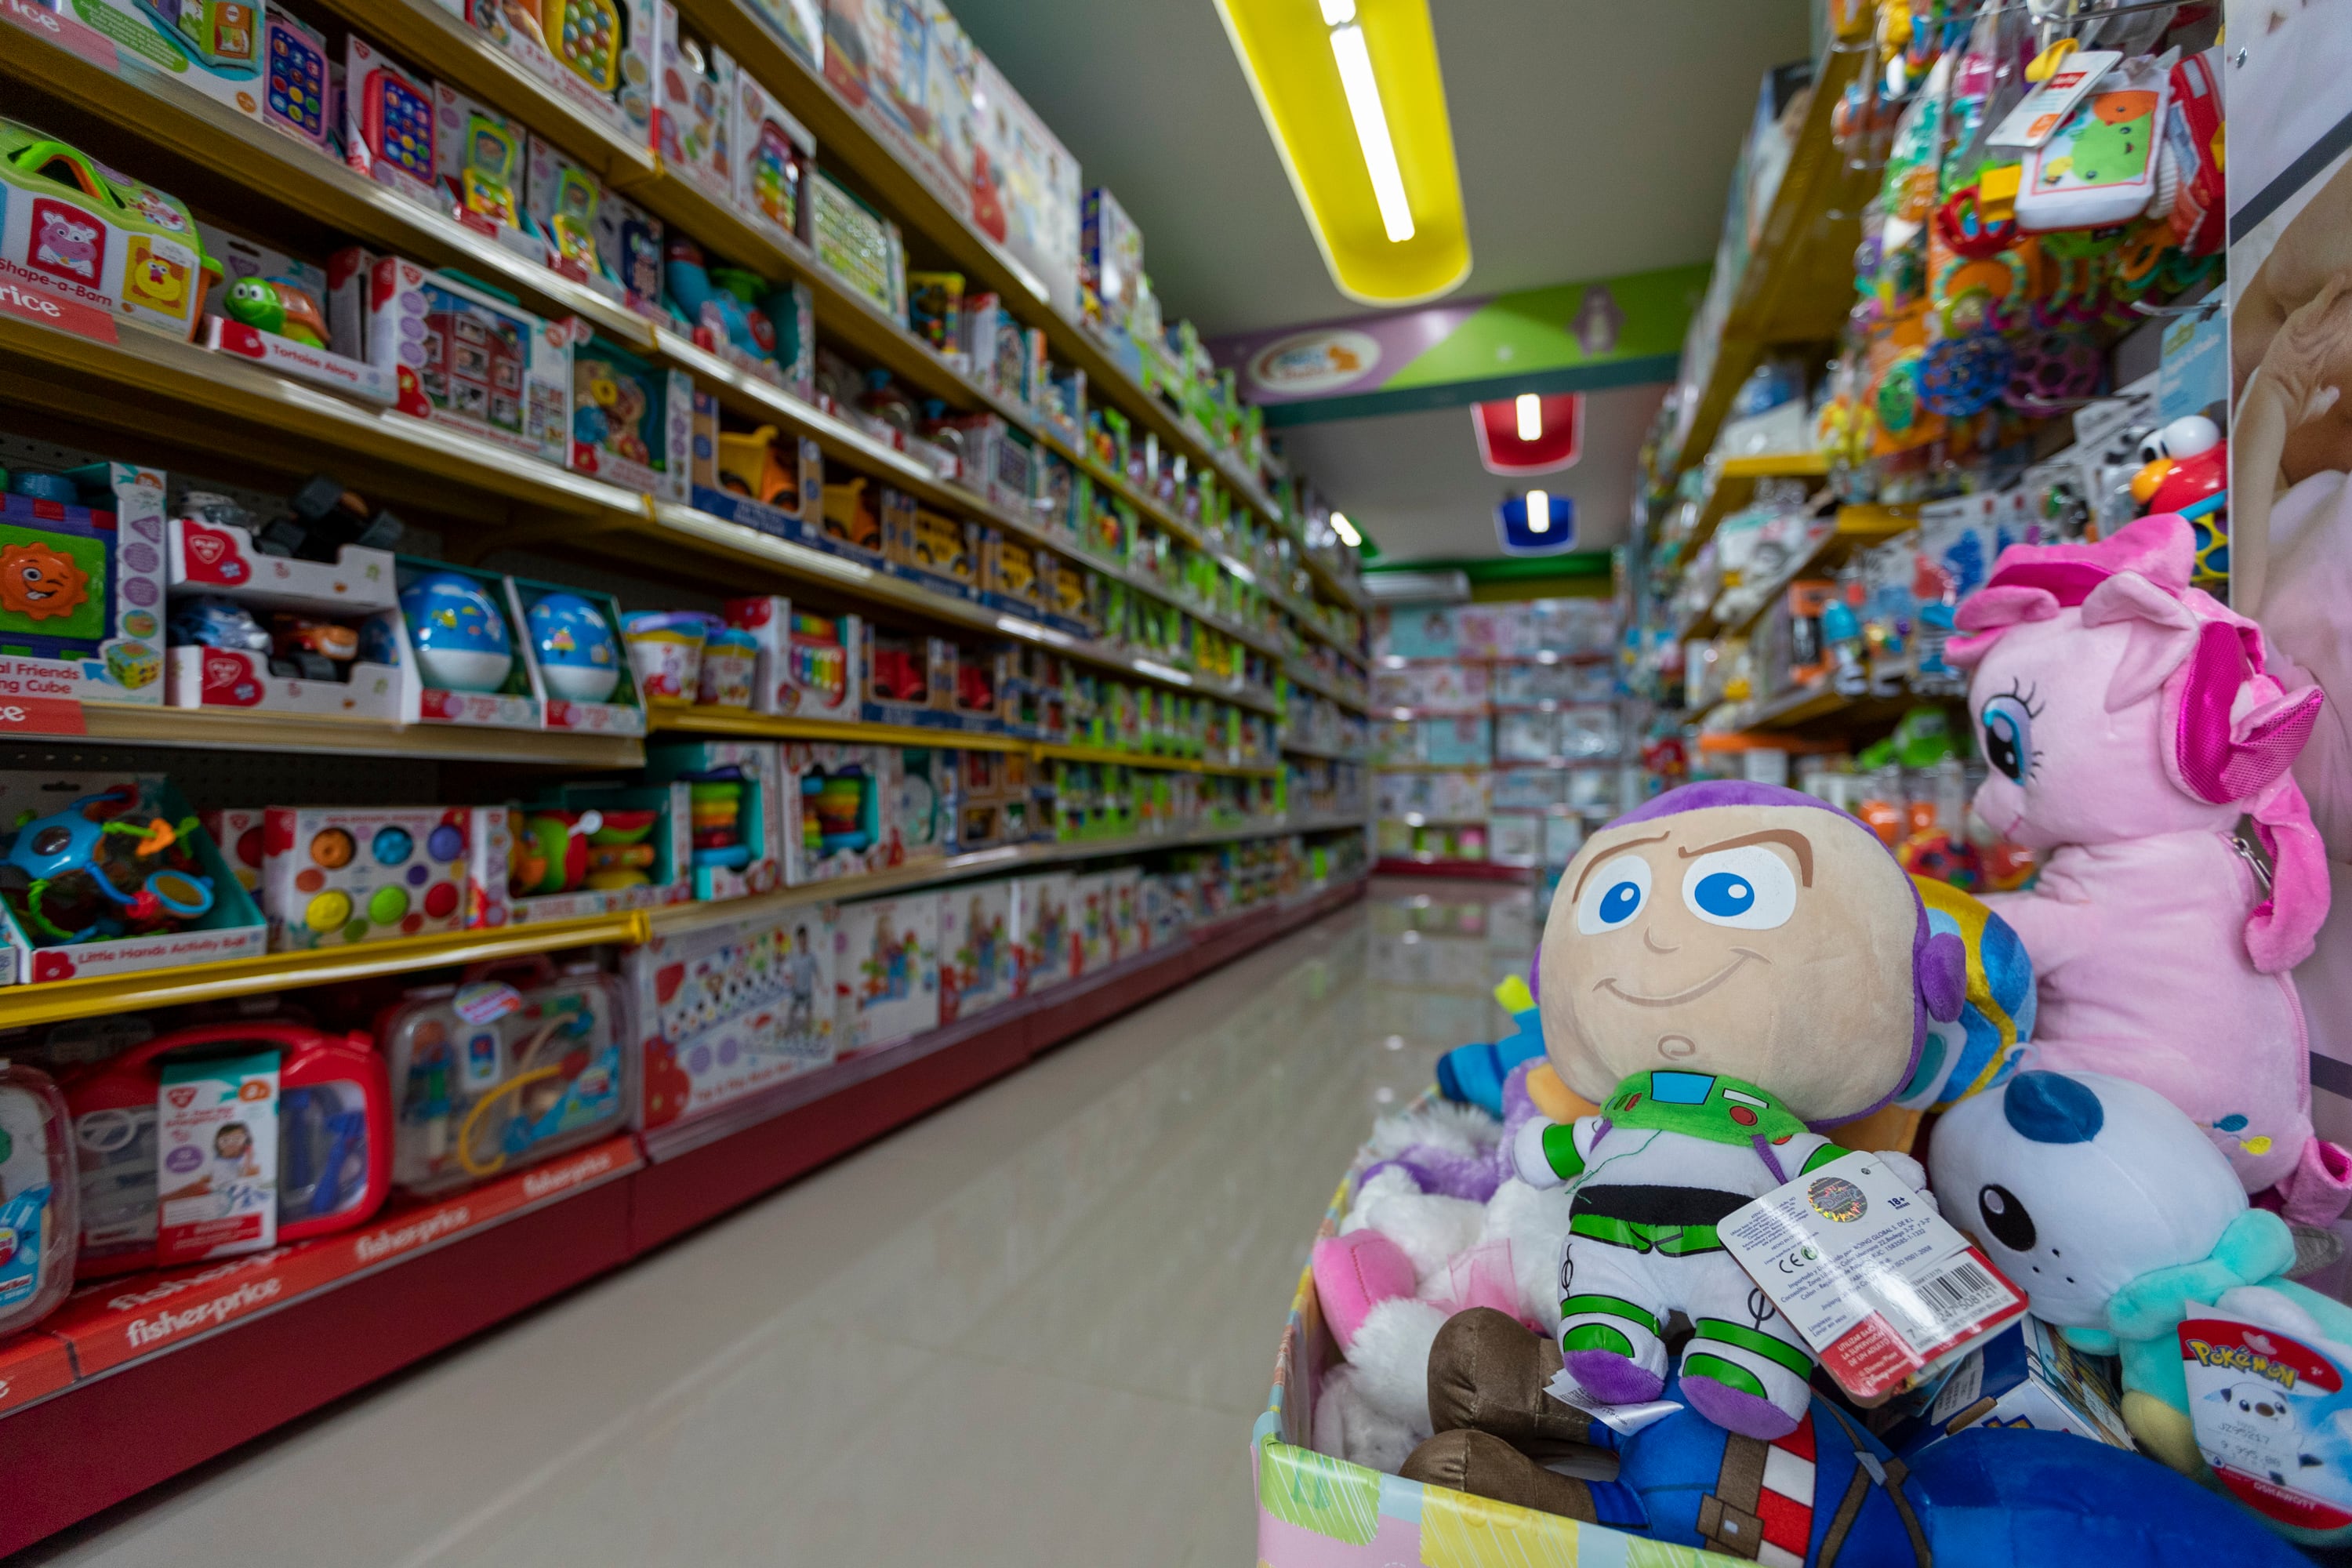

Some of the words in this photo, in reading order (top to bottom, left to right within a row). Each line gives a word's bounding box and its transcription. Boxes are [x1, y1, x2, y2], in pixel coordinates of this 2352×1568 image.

[273, 343, 321, 368] Tortoise
[324, 362, 359, 383] Along
[17, 664, 80, 680] Friends
[27, 680, 71, 695] Cube
[78, 951, 115, 964] Little
[119, 946, 165, 960] Hands
[170, 940, 218, 956] Activity
[223, 936, 246, 948] Ball
[523, 1152, 612, 1198] fisher-price
[1887, 1196, 1904, 1206] 18+
[354, 1206, 470, 1263] fisher-price
[1788, 1272, 1813, 1288] Importado
[1871, 1228, 1892, 1240] GLOBAL
[125, 1276, 283, 1349] fisher-price
[1960, 1287, 1996, 1310] 508121
[1837, 1334, 1860, 1351] UTILIZAR
[1867, 1338, 1889, 1355] ADULTO
[2186, 1338, 2299, 1390] Pokémon
